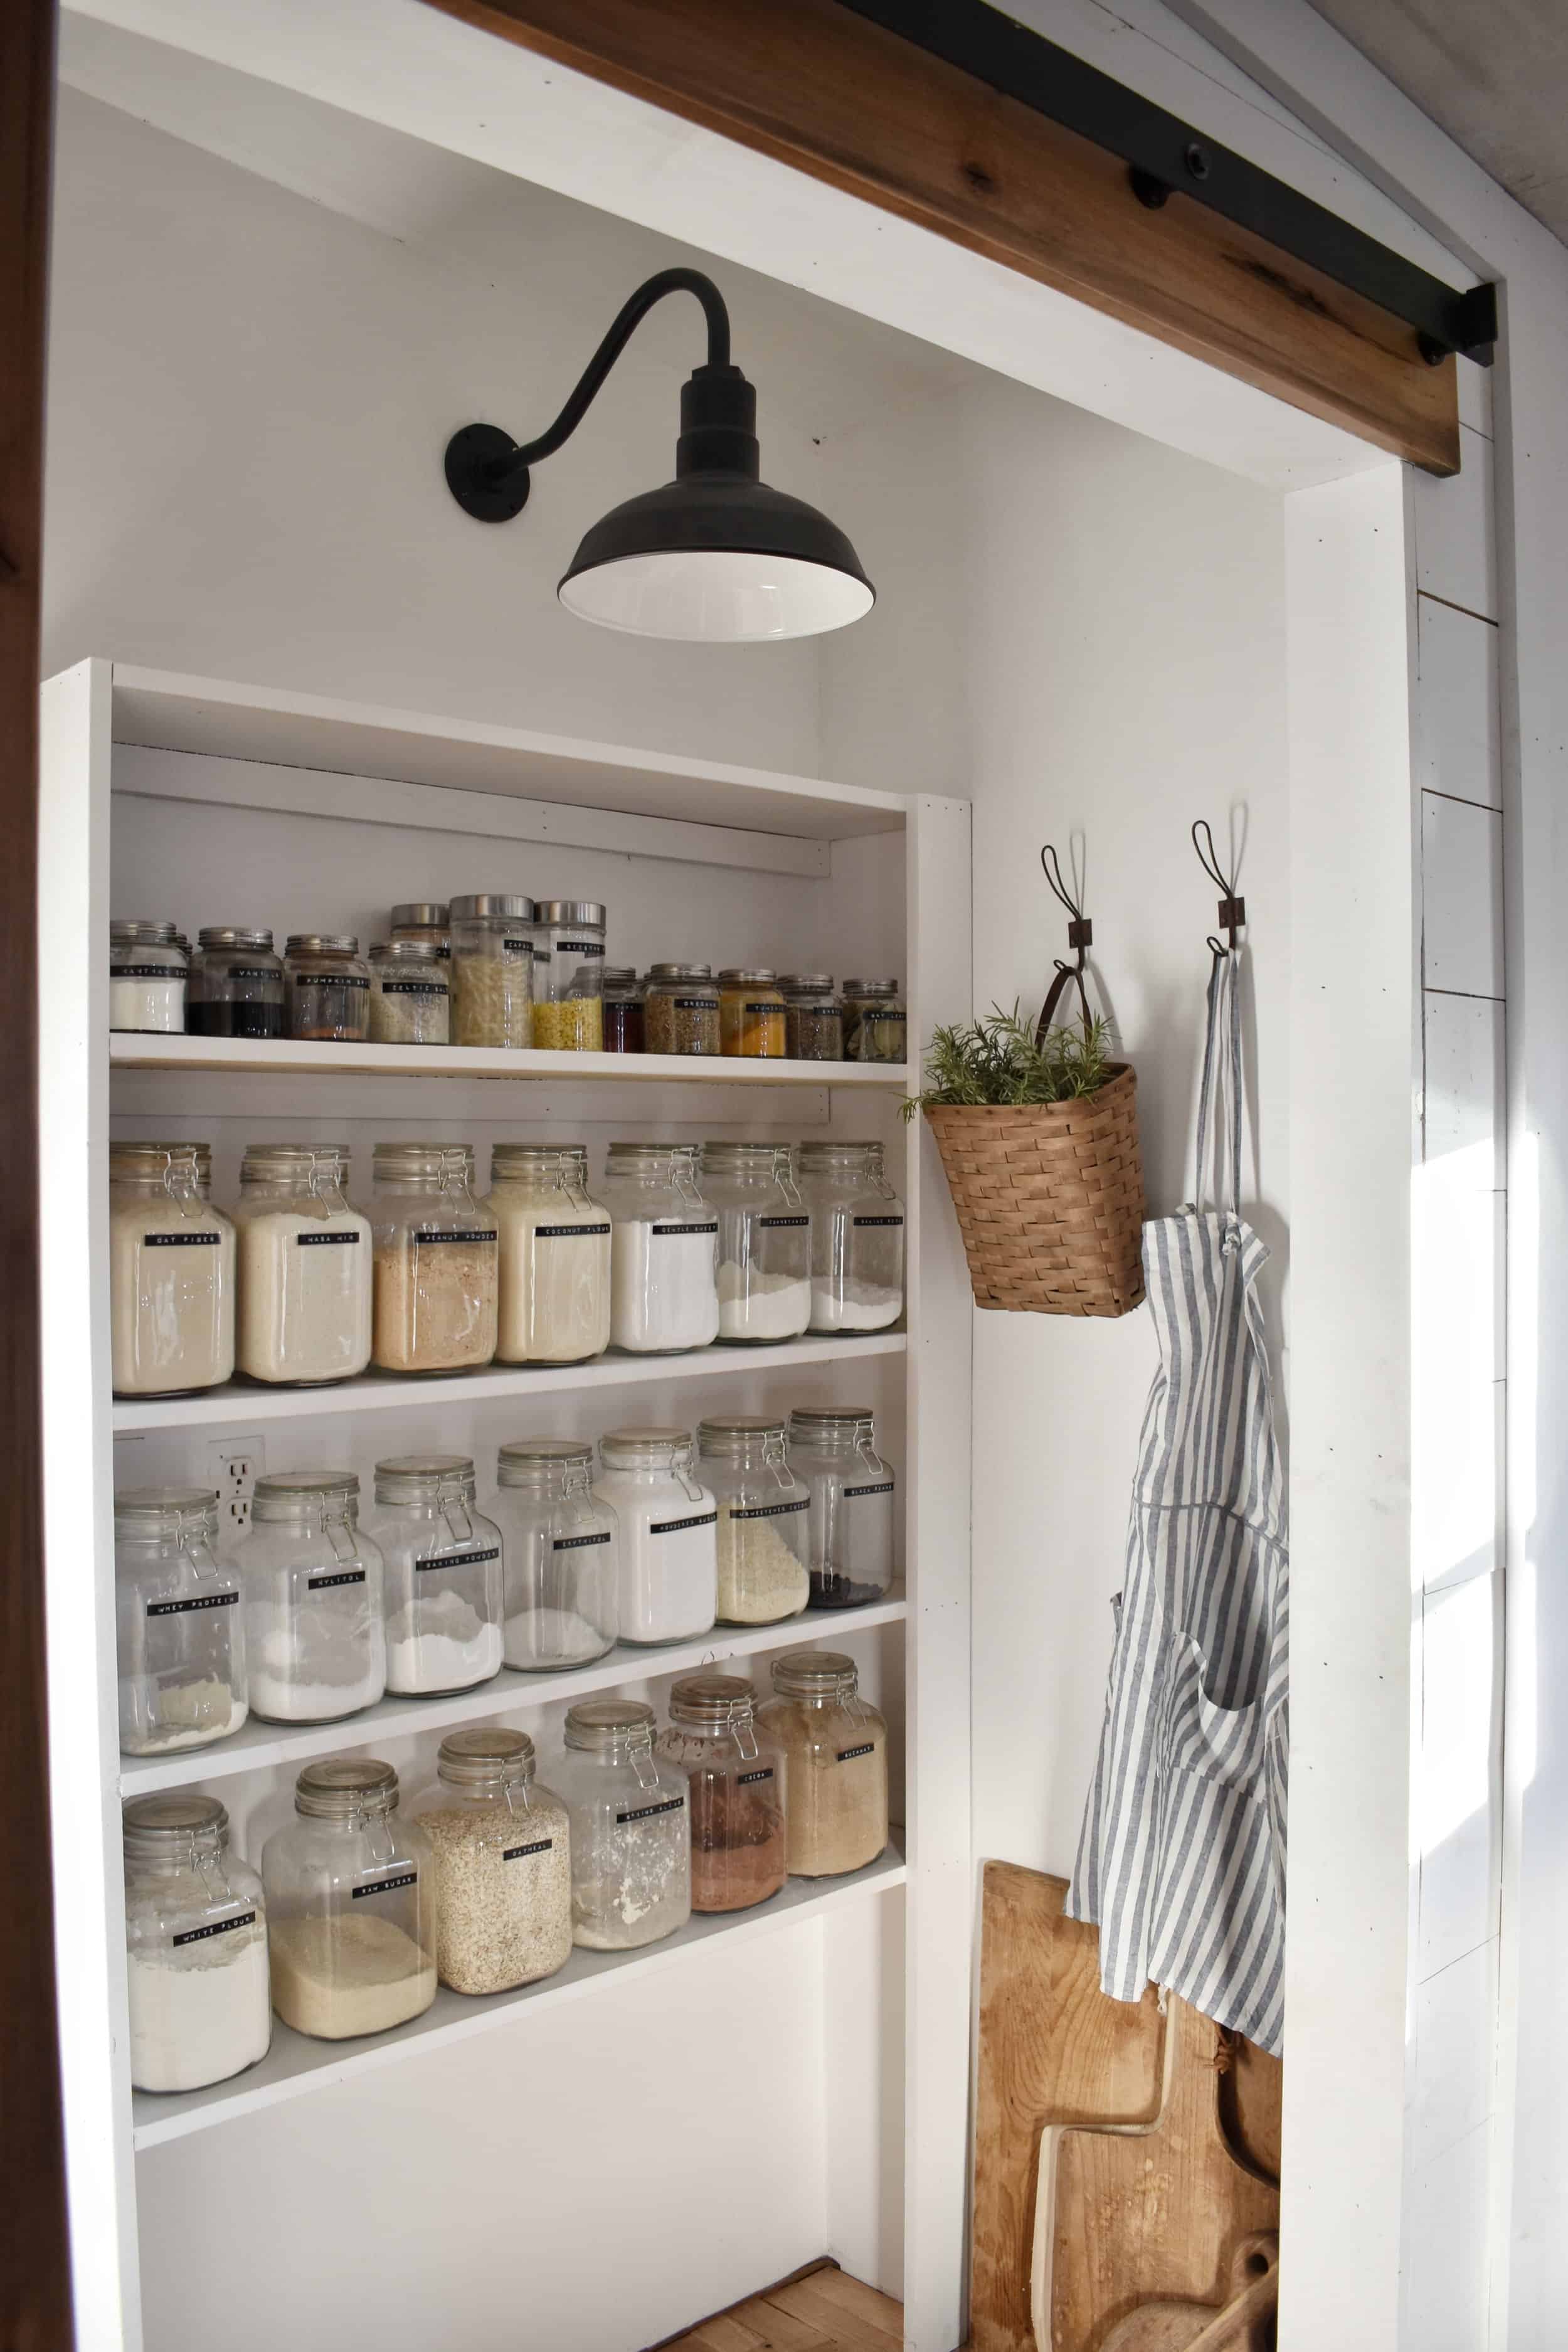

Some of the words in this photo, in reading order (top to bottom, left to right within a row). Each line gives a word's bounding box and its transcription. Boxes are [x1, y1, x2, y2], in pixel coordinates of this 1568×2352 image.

[661, 1226, 689, 1234] GENTLE
[156, 1236, 176, 1244] OAT
[183, 1235, 215, 1244] FIBER
[425, 1234, 458, 1242] PEANUT
[659, 1519, 695, 1531] POWDERED
[425, 1556, 461, 1569] BAKING
[465, 1551, 496, 1562] POWDER
[317, 1575, 362, 1586] XYLITOL
[157, 1604, 184, 1614] WHEY
[191, 1596, 235, 1608] PROTEIN
[744, 1771, 765, 1782] COCOA
[625, 1808, 654, 1821] BAKING
[659, 1799, 682, 1812] BLEND
[511, 1843, 548, 1858] OATMEAL
[361, 1885, 380, 1894] RAW
[383, 1876, 413, 1890] SUGAR
[182, 1927, 216, 1943] WHITE
[220, 1916, 252, 1929] FLOUR
